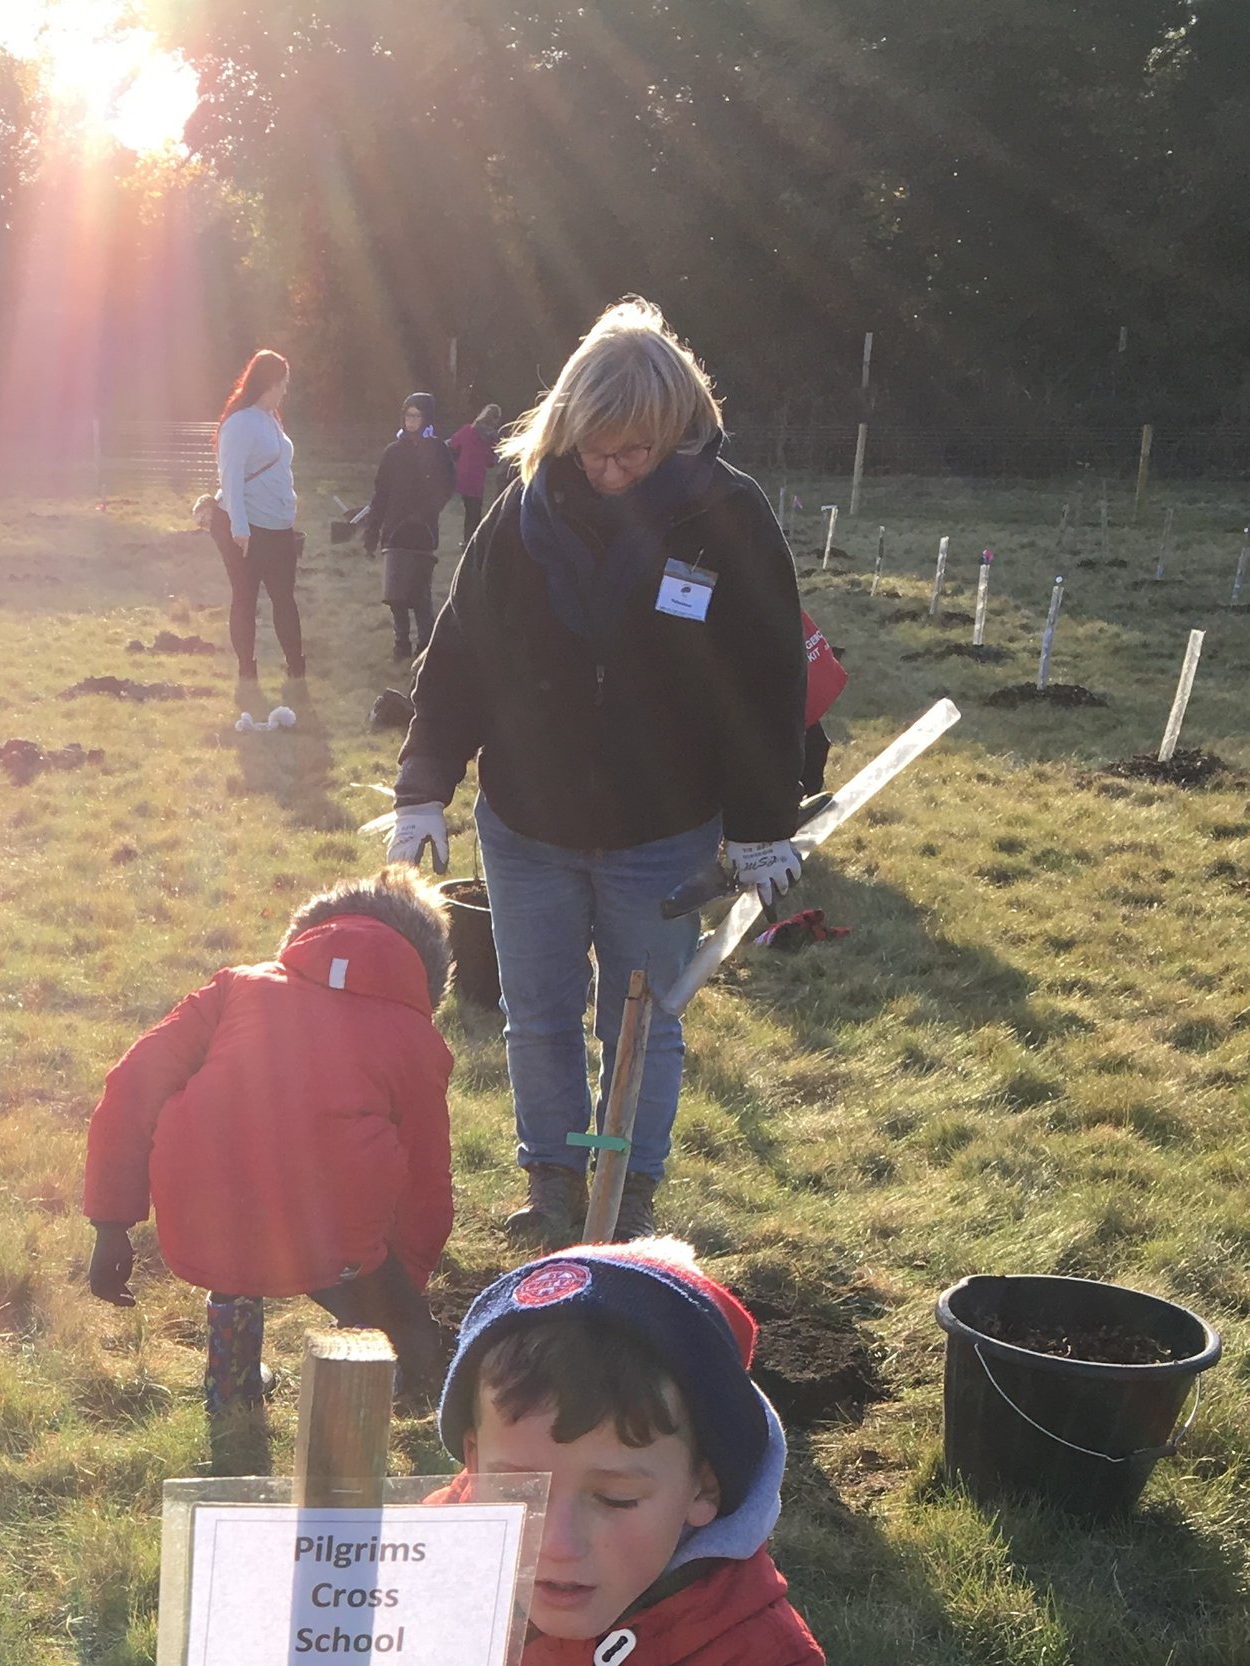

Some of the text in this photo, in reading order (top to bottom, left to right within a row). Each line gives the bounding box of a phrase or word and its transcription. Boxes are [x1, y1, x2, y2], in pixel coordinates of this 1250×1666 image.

[806, 646, 820, 662] KIT
[294, 1534, 426, 1569] Pilgrims
[311, 1582, 399, 1608] Cross
[295, 1626, 405, 1653] School
